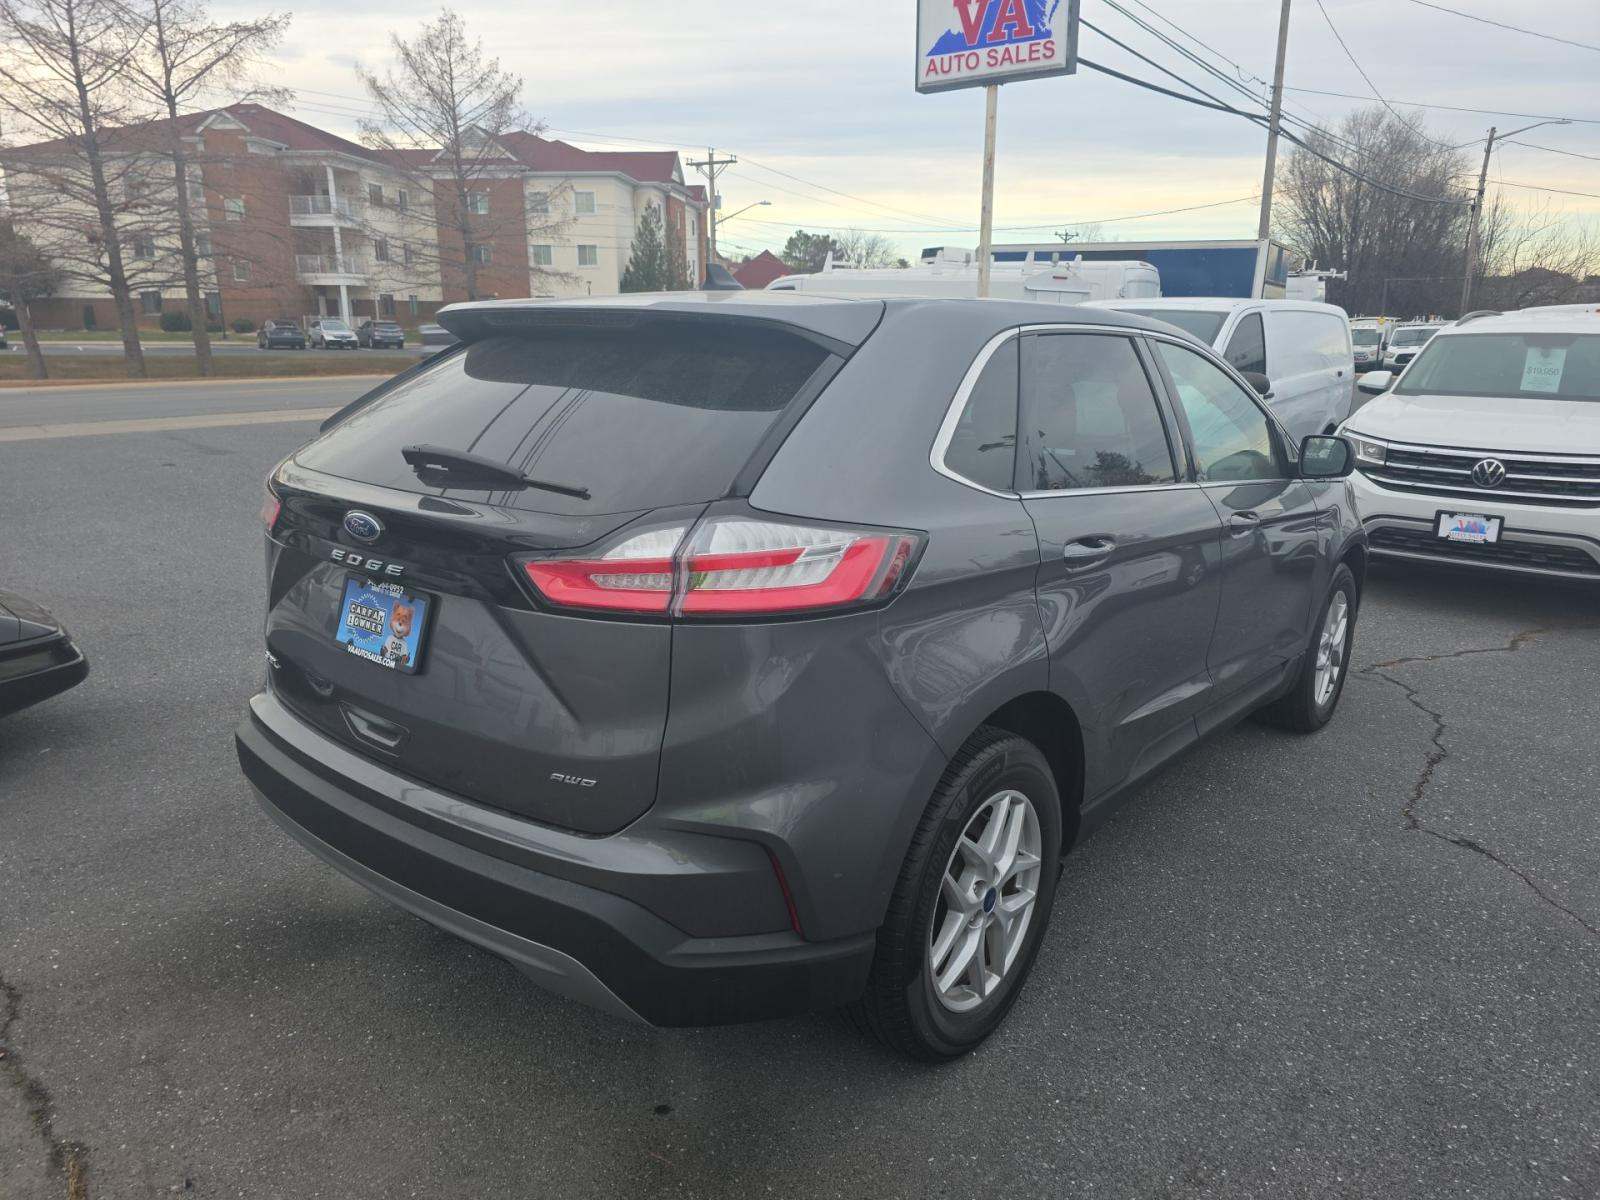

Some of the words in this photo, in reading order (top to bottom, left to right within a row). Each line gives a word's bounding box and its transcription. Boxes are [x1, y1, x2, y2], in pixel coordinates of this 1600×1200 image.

[953, 0, 1034, 46] VA
[925, 52, 979, 77] AUTO
[987, 40, 1055, 67] SALES
[331, 548, 404, 576] EDGE
[351, 604, 385, 624] CARFAX
[550, 773, 597, 786] AWD
